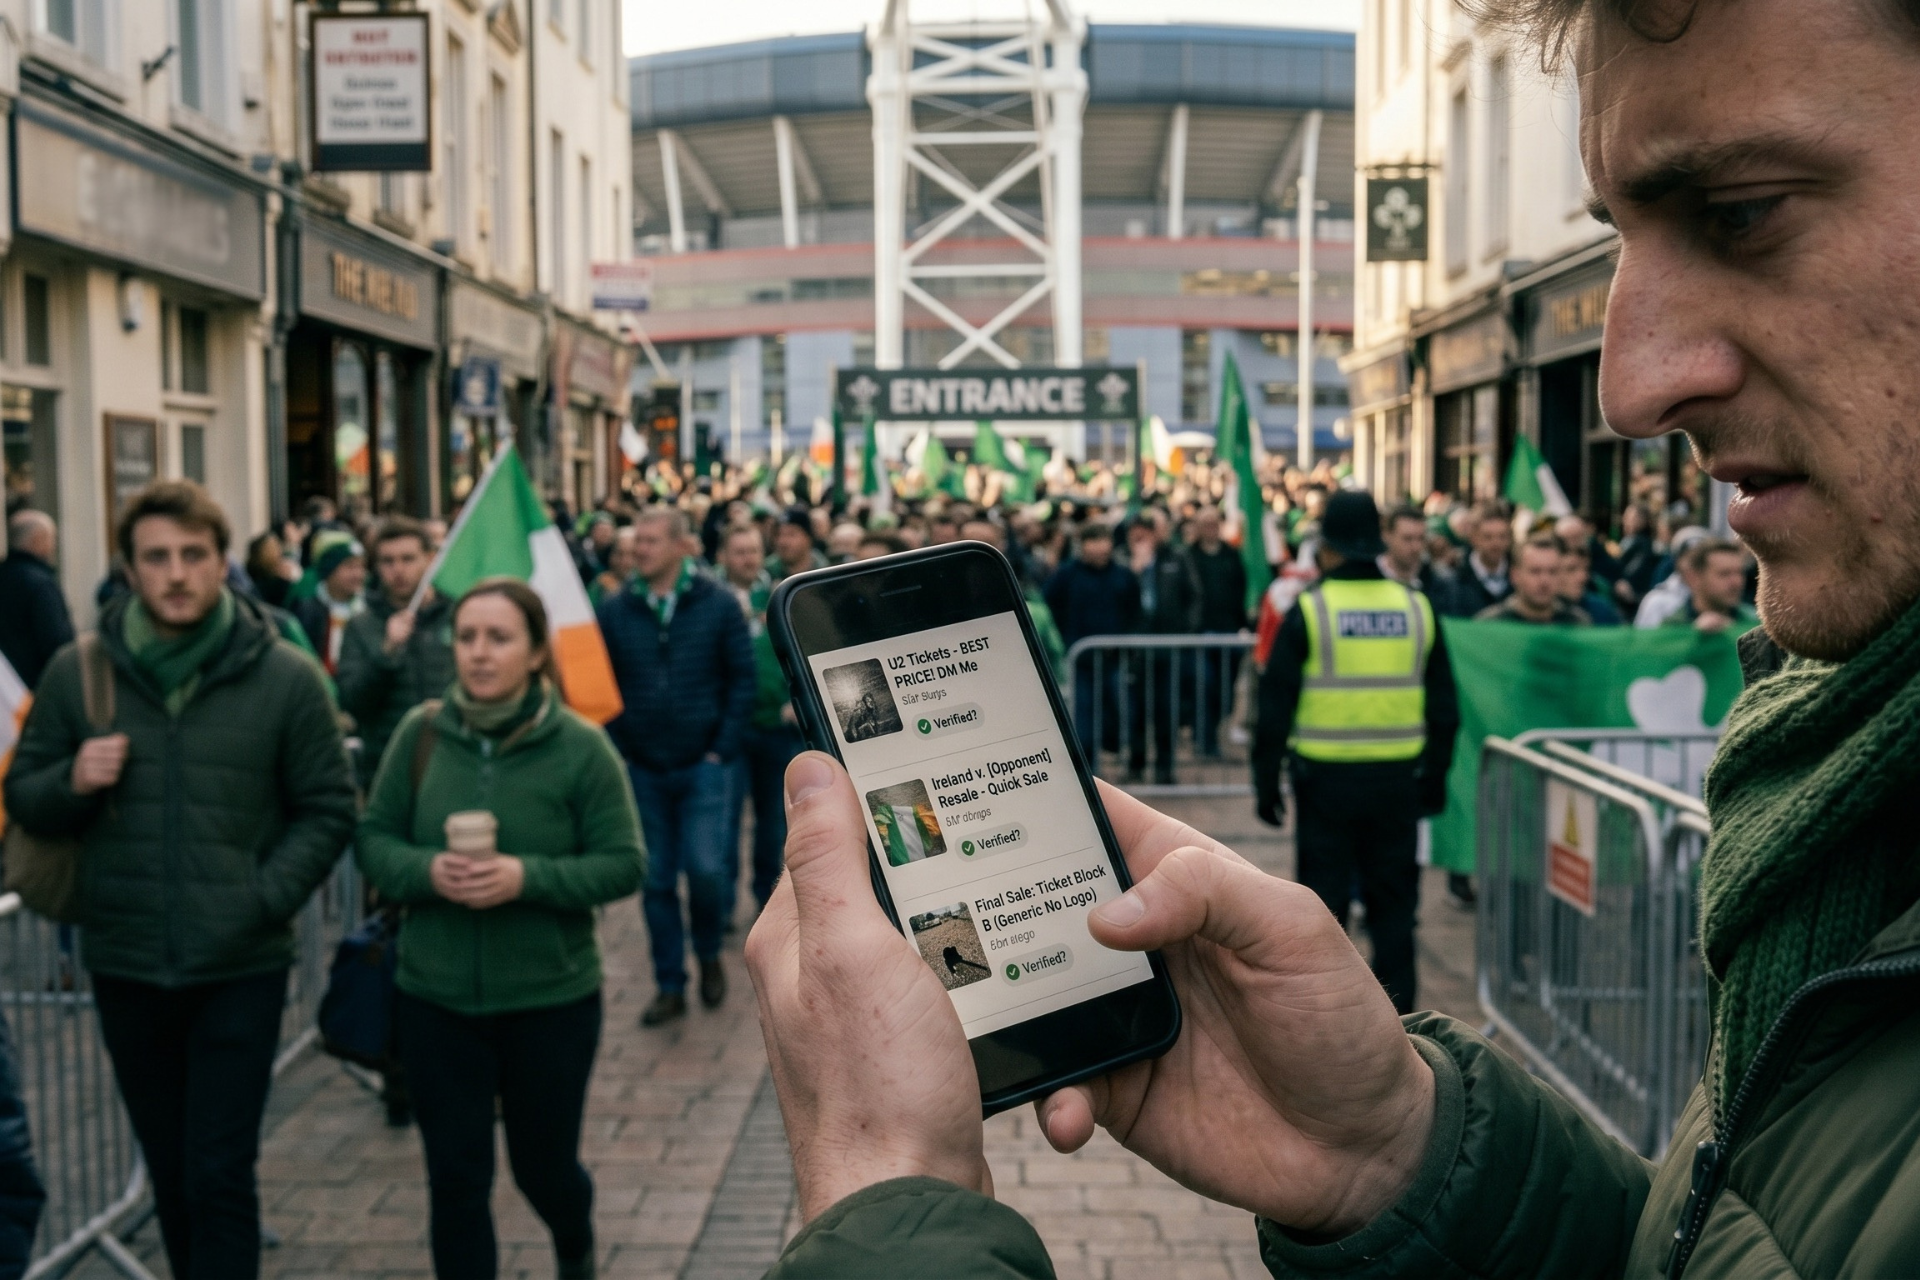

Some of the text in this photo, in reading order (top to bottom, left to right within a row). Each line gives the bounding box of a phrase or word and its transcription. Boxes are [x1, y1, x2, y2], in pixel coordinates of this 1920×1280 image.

[889, 376, 1086, 415] ENTRANCE
[1339, 612, 1405, 635] POLICE
[887, 656, 906, 670] U2
[906, 647, 951, 666] Tickets
[959, 637, 989, 654] BEST
[894, 660, 978, 688] PRICE! DM Me
[933, 709, 977, 728] Verified?
[931, 747, 1052, 790] Ireland v. [Opponent]
[937, 788, 979, 808] Resale
[1022, 770, 1049, 786] Sale
[977, 829, 1021, 850] Verified?
[974, 865, 1106, 913] Final Sale: Ticket Block
[981, 886, 1097, 932] B (Generic No Logo)
[1021, 950, 1067, 974] Verified?
